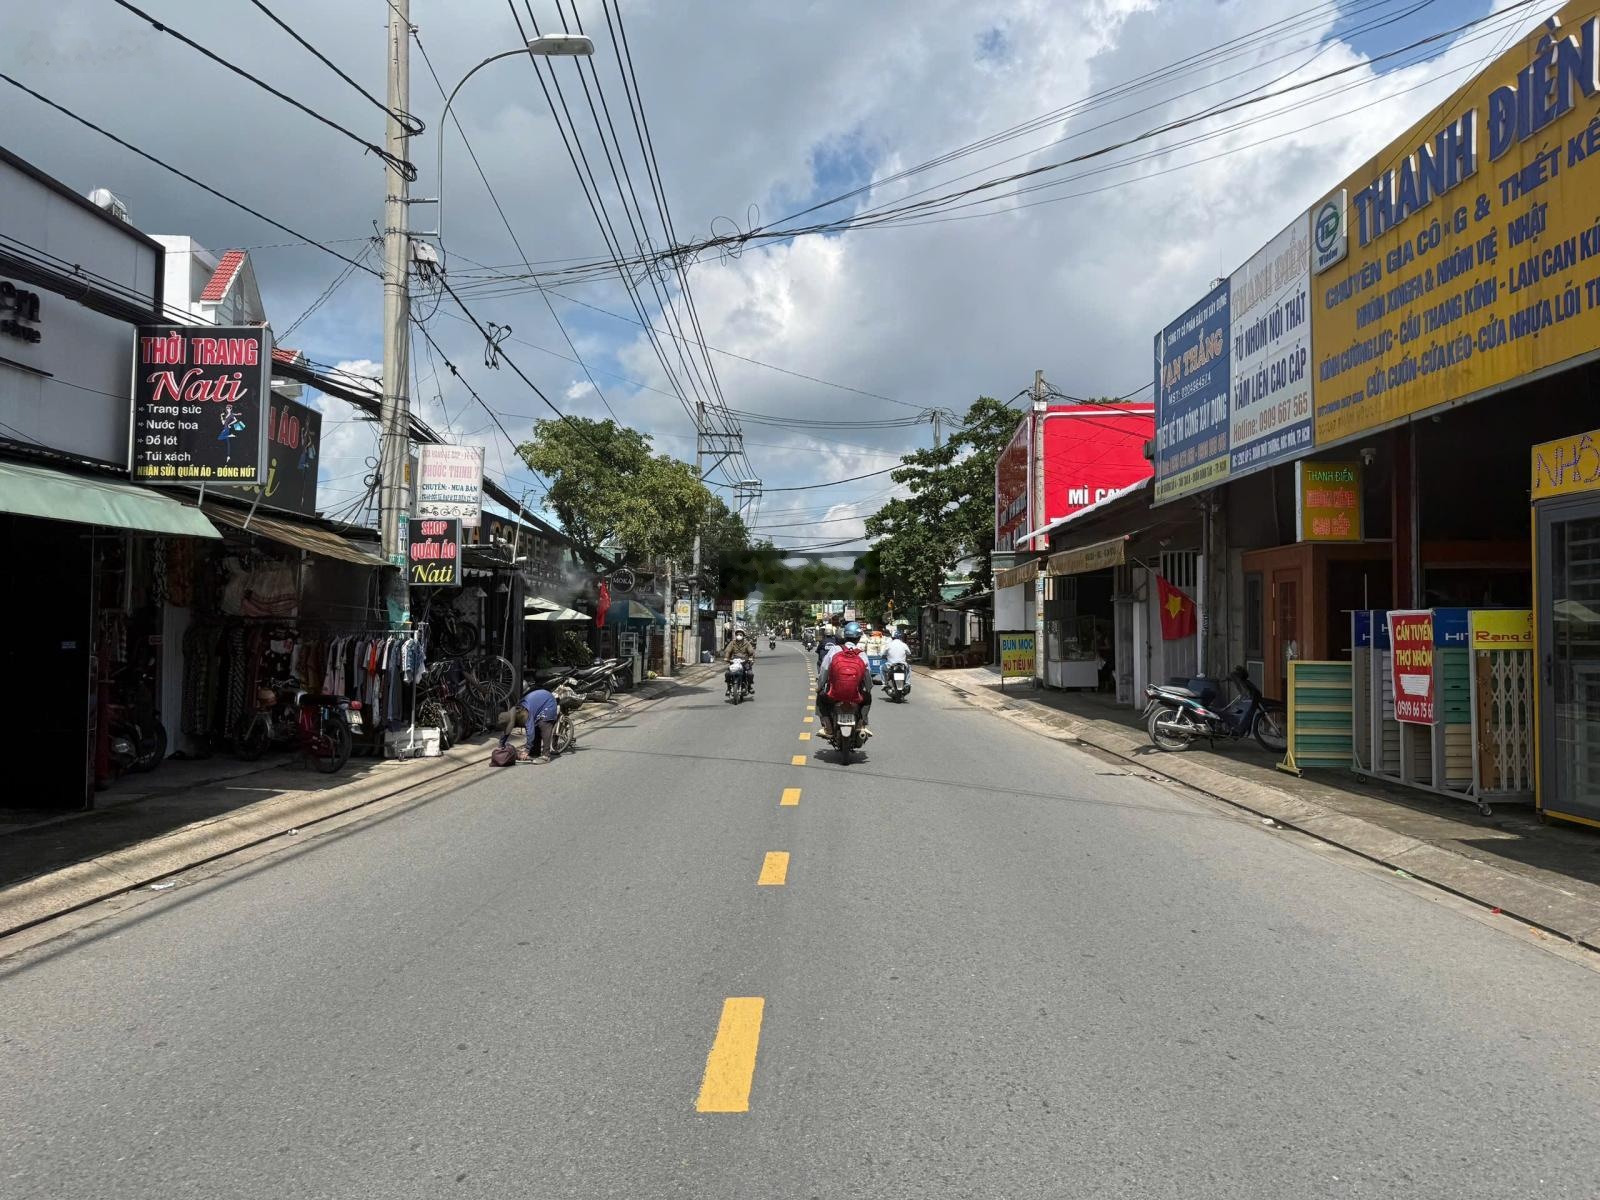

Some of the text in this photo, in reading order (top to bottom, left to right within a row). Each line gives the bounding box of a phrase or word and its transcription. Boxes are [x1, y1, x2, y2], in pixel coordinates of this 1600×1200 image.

[1353, 15, 1600, 247] THANH ĐIỀN
[1326, 258, 1382, 309] CHUYÊN
[1386, 240, 1414, 274] GIA
[1473, 193, 1491, 222] &
[1498, 142, 1563, 207] THIẾT
[1436, 244, 1473, 287] NHÔM
[1508, 202, 1548, 249] NHẬT
[1423, 293, 1463, 335] THANG
[1464, 278, 1497, 316] KÍNH
[1509, 255, 1540, 294] LAN
[1541, 236, 1577, 279] CAN
[1245, 317, 1268, 357] NHÔM
[1269, 302, 1283, 345] NỘI
[1285, 282, 1306, 332] THẤT
[1508, 299, 1553, 342] NHỰA
[141, 330, 258, 366] THỜI TRANG
[1252, 361, 1269, 403] LIỀN
[1270, 359, 1287, 393] CAO
[1289, 338, 1307, 384] CẤP
[146, 367, 248, 402] Nati
[146, 403, 202, 416] Trang sức
[1184, 402, 1198, 439] CÔNG
[1233, 418, 1258, 444] Hotline:
[1260, 405, 1276, 433] 0909
[1278, 398, 1291, 424] 667
[1293, 391, 1309, 418] 565
[146, 419, 199, 430] Nước hoa
[277, 404, 300, 449] ÁO
[163, 435, 178, 446] lót
[145, 451, 191, 462] Túi xách
[137, 464, 159, 479] NHẬN
[160, 463, 176, 477] SỬA
[178, 463, 199, 478] QUẦN
[200, 464, 211, 477] ÁO
[217, 464, 239, 478] ĐÓNG
[240, 464, 256, 478] NÚT
[1307, 470, 1334, 482] THANH
[1068, 484, 1089, 505] MÌ
[421, 520, 448, 536] SHOP
[411, 538, 440, 561] QUẦN
[440, 538, 457, 559] ÁO
[411, 562, 455, 583] Nati
[612, 577, 632, 585] MOKA
[1396, 649, 1411, 671] THỢ
[1397, 700, 1412, 717] 0909
[1412, 701, 1420, 718] 66
